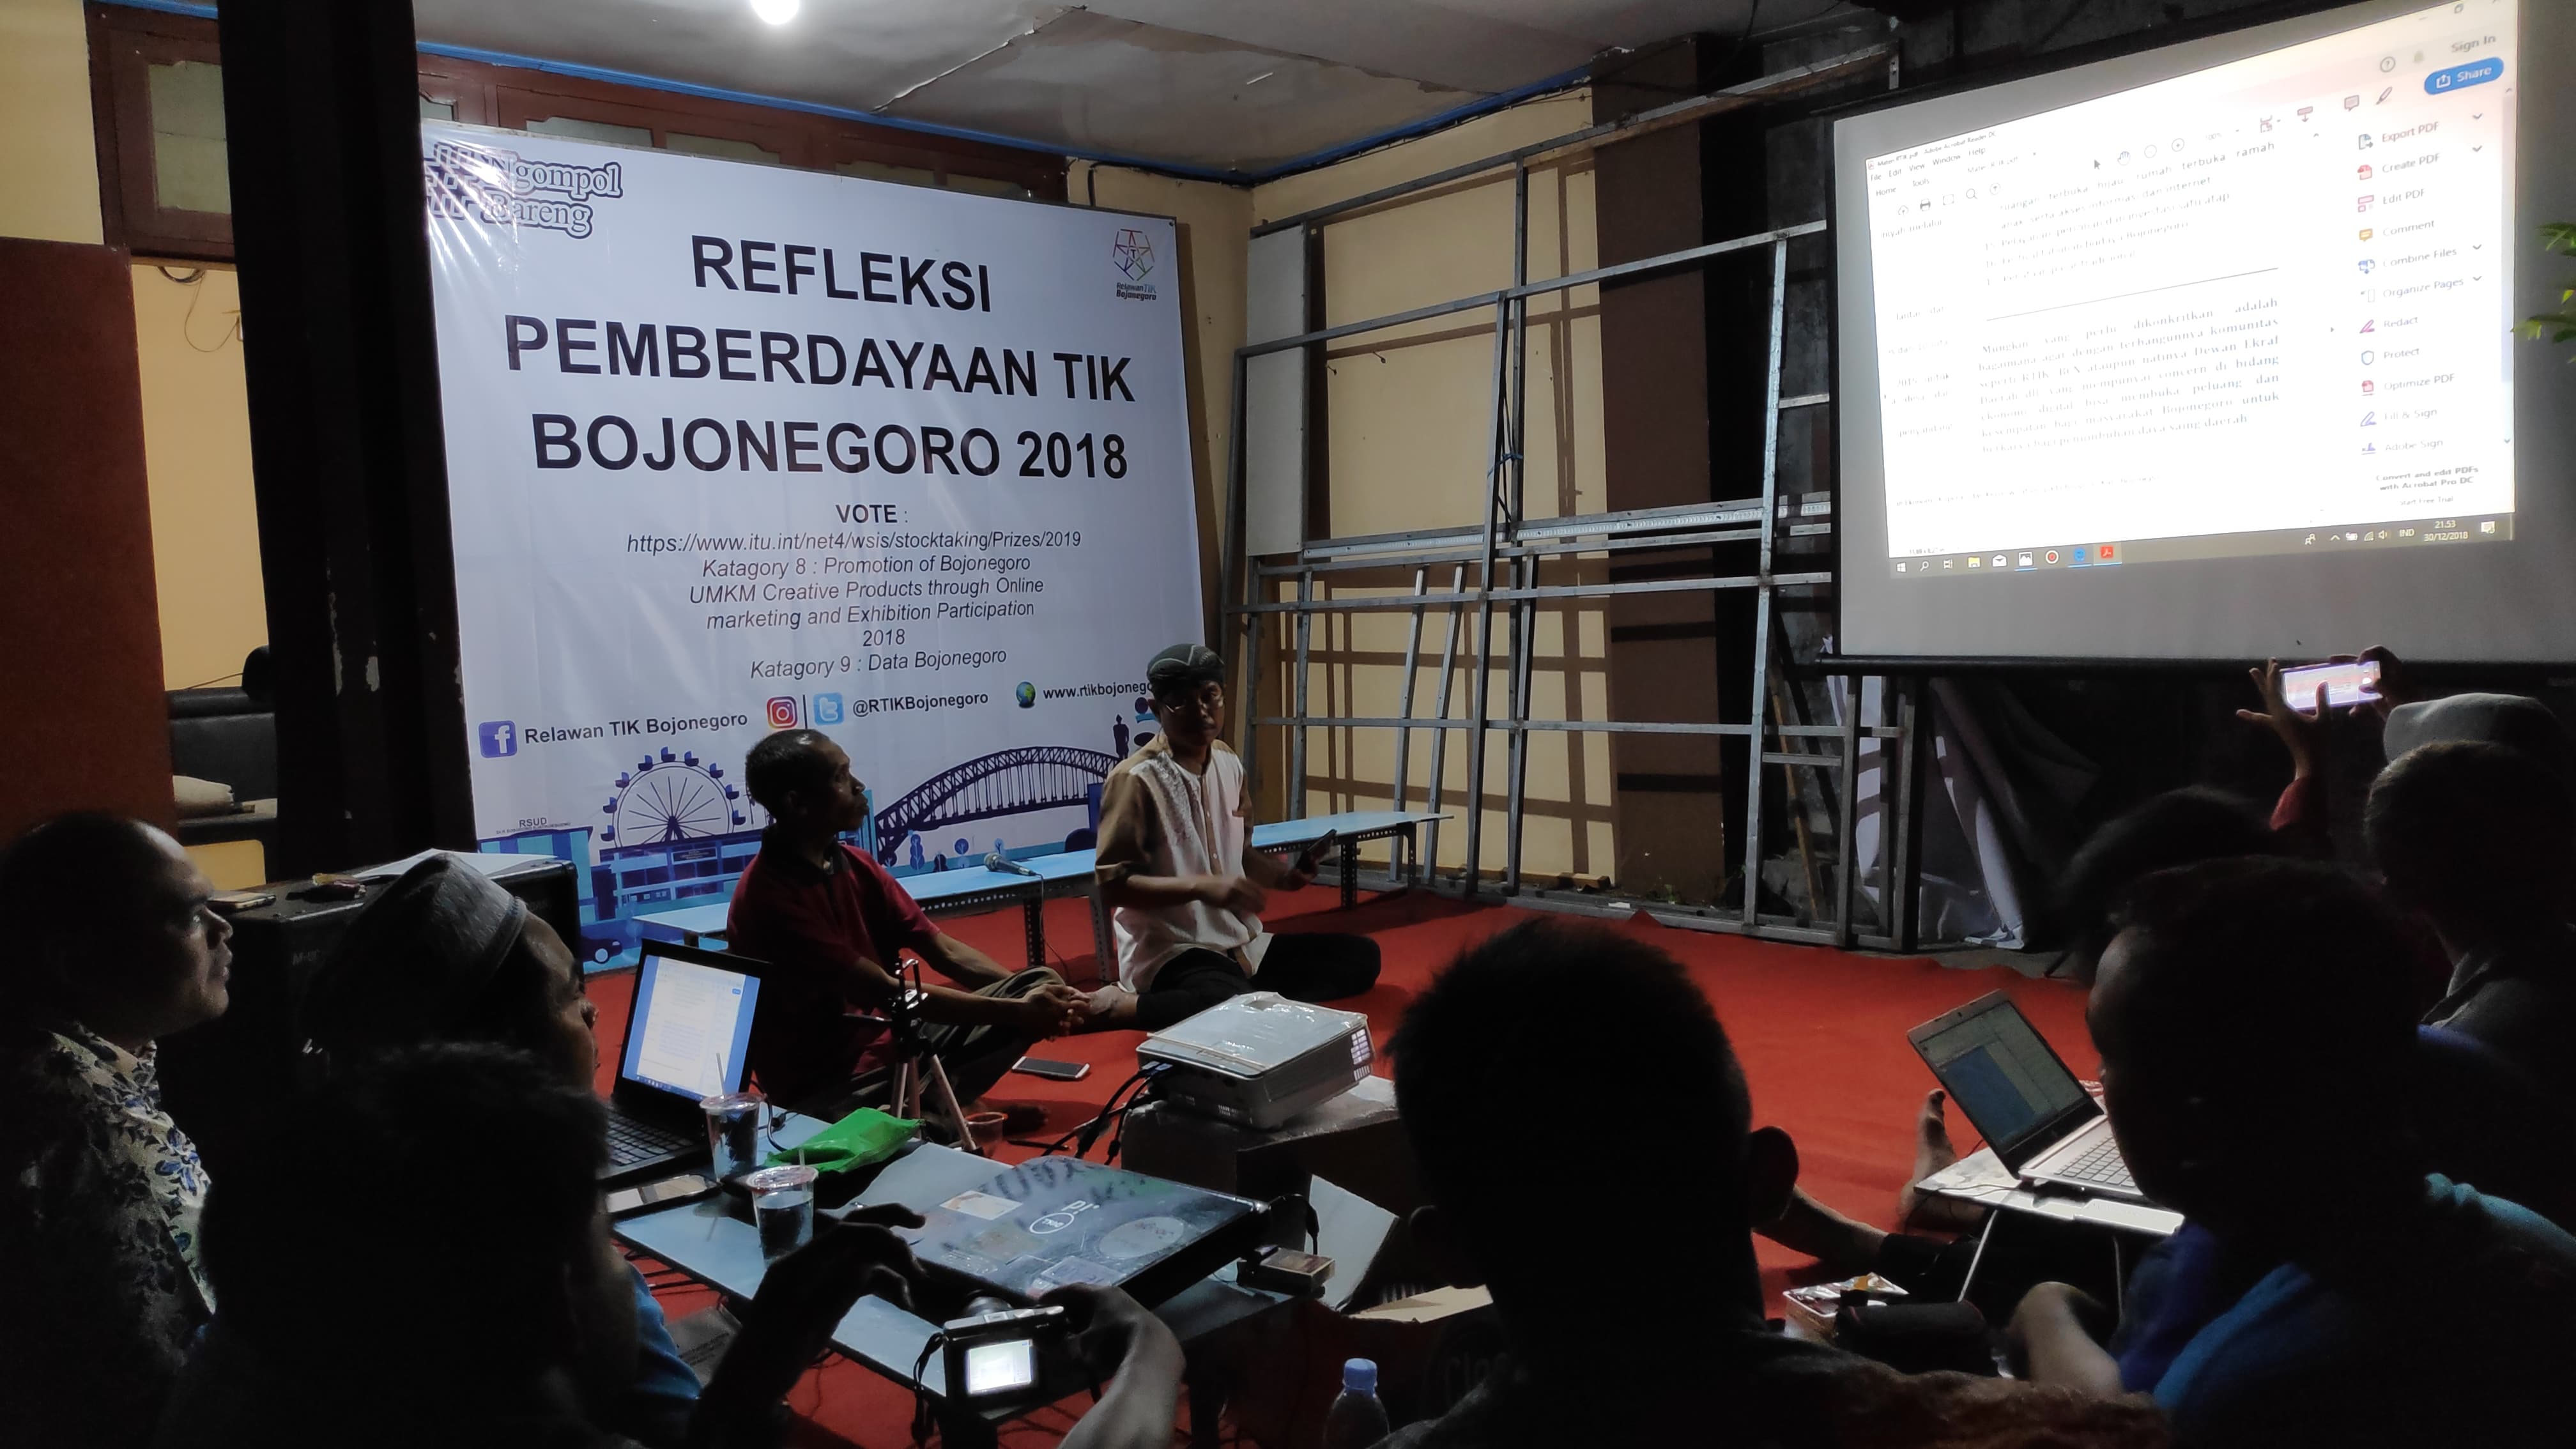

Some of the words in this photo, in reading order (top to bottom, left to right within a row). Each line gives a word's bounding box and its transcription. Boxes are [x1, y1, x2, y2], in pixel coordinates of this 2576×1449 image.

[2451, 38, 2480, 53] Sign
[2483, 34, 2496, 45] In
[2457, 66, 2492, 82] Share
[2382, 128, 2416, 144] Export
[2418, 121, 2440, 134] PDF
[1889, 168, 1902, 178] Edit
[1909, 162, 1926, 172] View
[1932, 153, 1961, 166] Window
[1968, 147, 1986, 157] Help
[2182, 154, 2226, 170] terbuka
[2235, 141, 2275, 158] ramah
[2382, 158, 2416, 174] Create
[2418, 153, 2440, 166] PDF
[1875, 186, 1897, 197] Home
[2382, 193, 2402, 204] Edit
[2405, 188, 2425, 201] PDF
[488, 192, 588, 233] Bareng
[2382, 220, 2435, 236] Comment
[2433, 247, 2457, 259] Files
[691, 235, 991, 312] REFLEKSI
[1116, 289, 1157, 301] Bojonegoro
[2383, 283, 2431, 299] Organize
[2434, 278, 2464, 291] Pages
[2210, 319, 2279, 335] komunitas
[2384, 316, 2419, 328] Redact
[505, 314, 1038, 397] PEMBERDAYAAN
[1053, 352, 1135, 402] TIK
[2235, 355, 2280, 369] bidang
[2383, 348, 2420, 360] Protect
[2255, 373, 2280, 385] dan
[2384, 378, 2431, 392] Optimize
[2434, 373, 2455, 384] PDF
[2241, 391, 2280, 404] untuk
[2414, 407, 2438, 419] Sign
[532, 413, 1000, 477] BOJONEGORO
[1016, 431, 1128, 479] 2018
[2384, 441, 2418, 452] Adobe
[2419, 438, 2444, 450] Sign
[2376, 471, 2411, 482] Convert
[2414, 470, 2431, 478] and
[2434, 467, 2452, 476] edit
[2455, 465, 2480, 475] PDFs
[2379, 482, 2400, 491] with
[2402, 479, 2438, 490] Acrobat
[2441, 477, 2458, 486] Pro
[2459, 475, 2474, 484] DC
[835, 503, 898, 523] VOTE
[2398, 528, 2415, 538] IND
[2423, 531, 2469, 542] 30/12/2018
[627, 531, 1081, 556] https://www.itu.int/net4/wsis/stocktaking/Prizes/2019
[703, 558, 789, 580] Katagory
[795, 558, 806, 574] 8
[824, 556, 914, 574] Promotion
[919, 555, 937, 572] of
[940, 555, 1031, 575] Bojonegoro
[690, 584, 756, 604] UMKM
[763, 582, 839, 601] Creative
[846, 580, 923, 599] Products
[928, 577, 990, 598] through
[996, 577, 1044, 594] Online
[707, 609, 801, 630] marketing
[808, 607, 841, 625] and
[847, 604, 931, 623] Exhibition
[937, 601, 1034, 621] Participation
[862, 629, 905, 647] 2018
[751, 659, 834, 680] Katagory
[840, 656, 851, 673] 9
[868, 654, 908, 671] Data
[914, 650, 1008, 671] Bojonegoro
[852, 691, 989, 717] @RTIKBojonegoro
[525, 723, 604, 744] Relawan
[609, 719, 640, 737] TIK
[646, 713, 748, 735] Bojonegoro
[519, 817, 547, 828] RSUD
